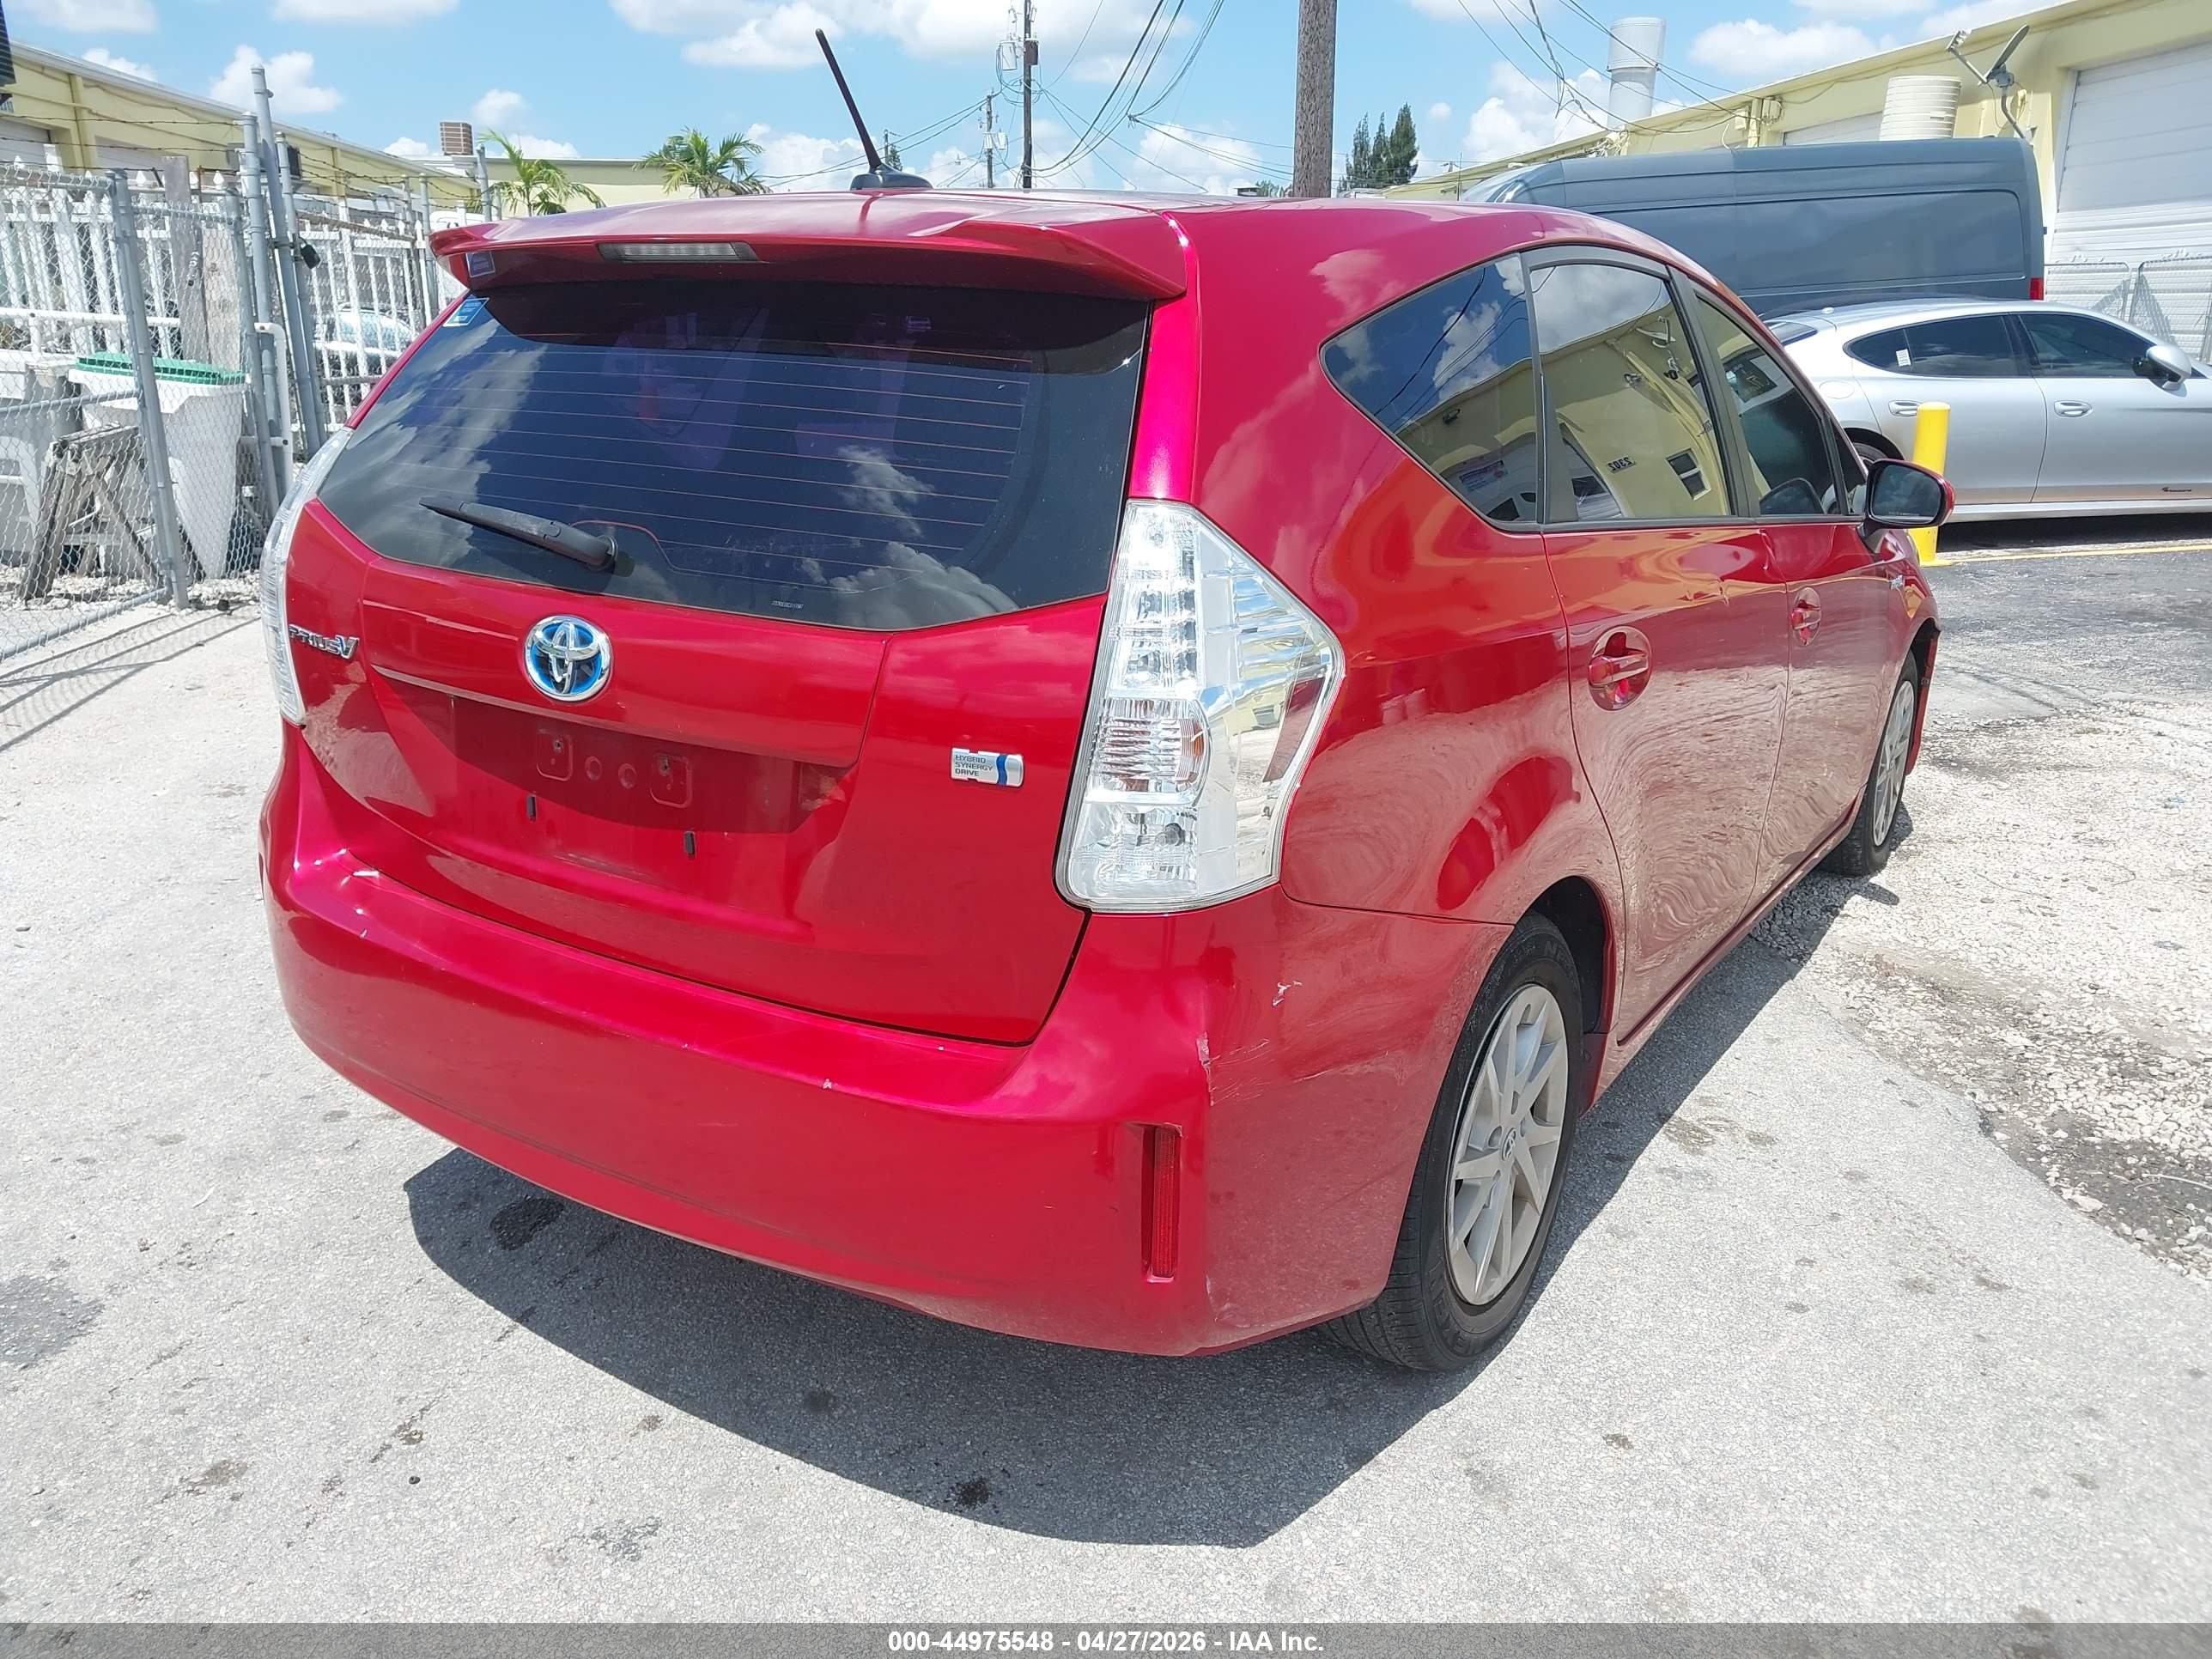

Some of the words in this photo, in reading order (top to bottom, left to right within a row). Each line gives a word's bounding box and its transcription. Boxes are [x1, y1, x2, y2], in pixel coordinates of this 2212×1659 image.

[955, 754, 987, 764] HYBRID
[955, 761, 994, 772] SYNERGY
[955, 768, 980, 777] DRIVE
